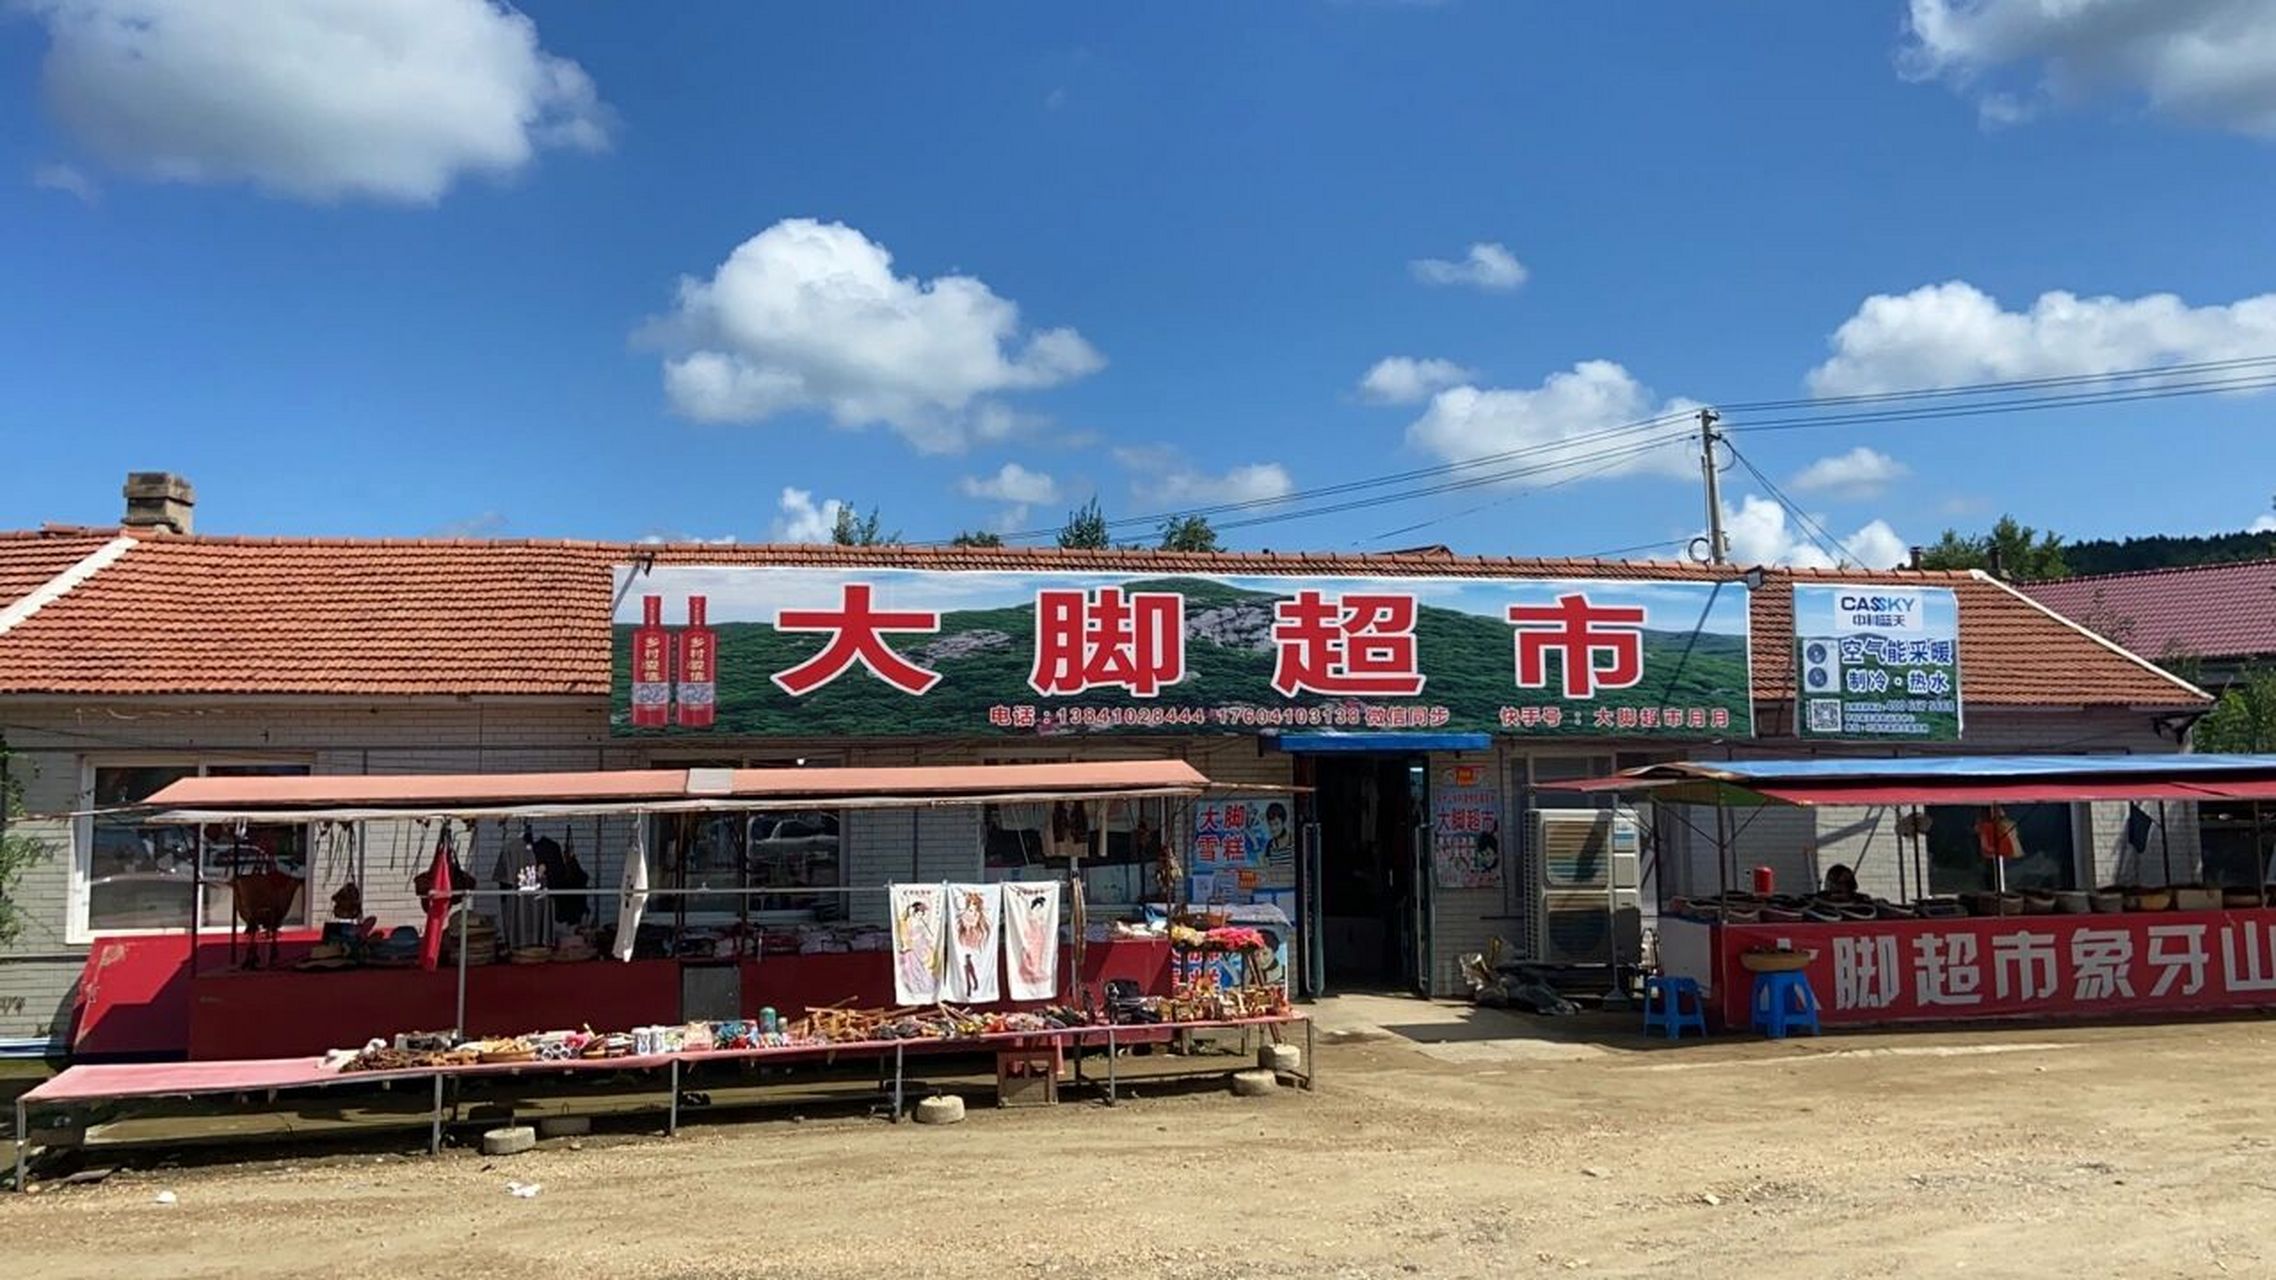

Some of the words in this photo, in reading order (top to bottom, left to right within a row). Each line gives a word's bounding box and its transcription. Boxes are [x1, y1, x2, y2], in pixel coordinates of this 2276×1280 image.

[1841, 596, 1915, 612] CASSKY
[771, 584, 1649, 698] 大脚超市
[1841, 638, 1953, 665] 空气能采暖
[1364, 705, 1450, 726] 微信同步
[1198, 804, 1247, 830] 大脚
[1436, 808, 1495, 833] 大脚超市
[1195, 833, 1247, 863] 雪糕
